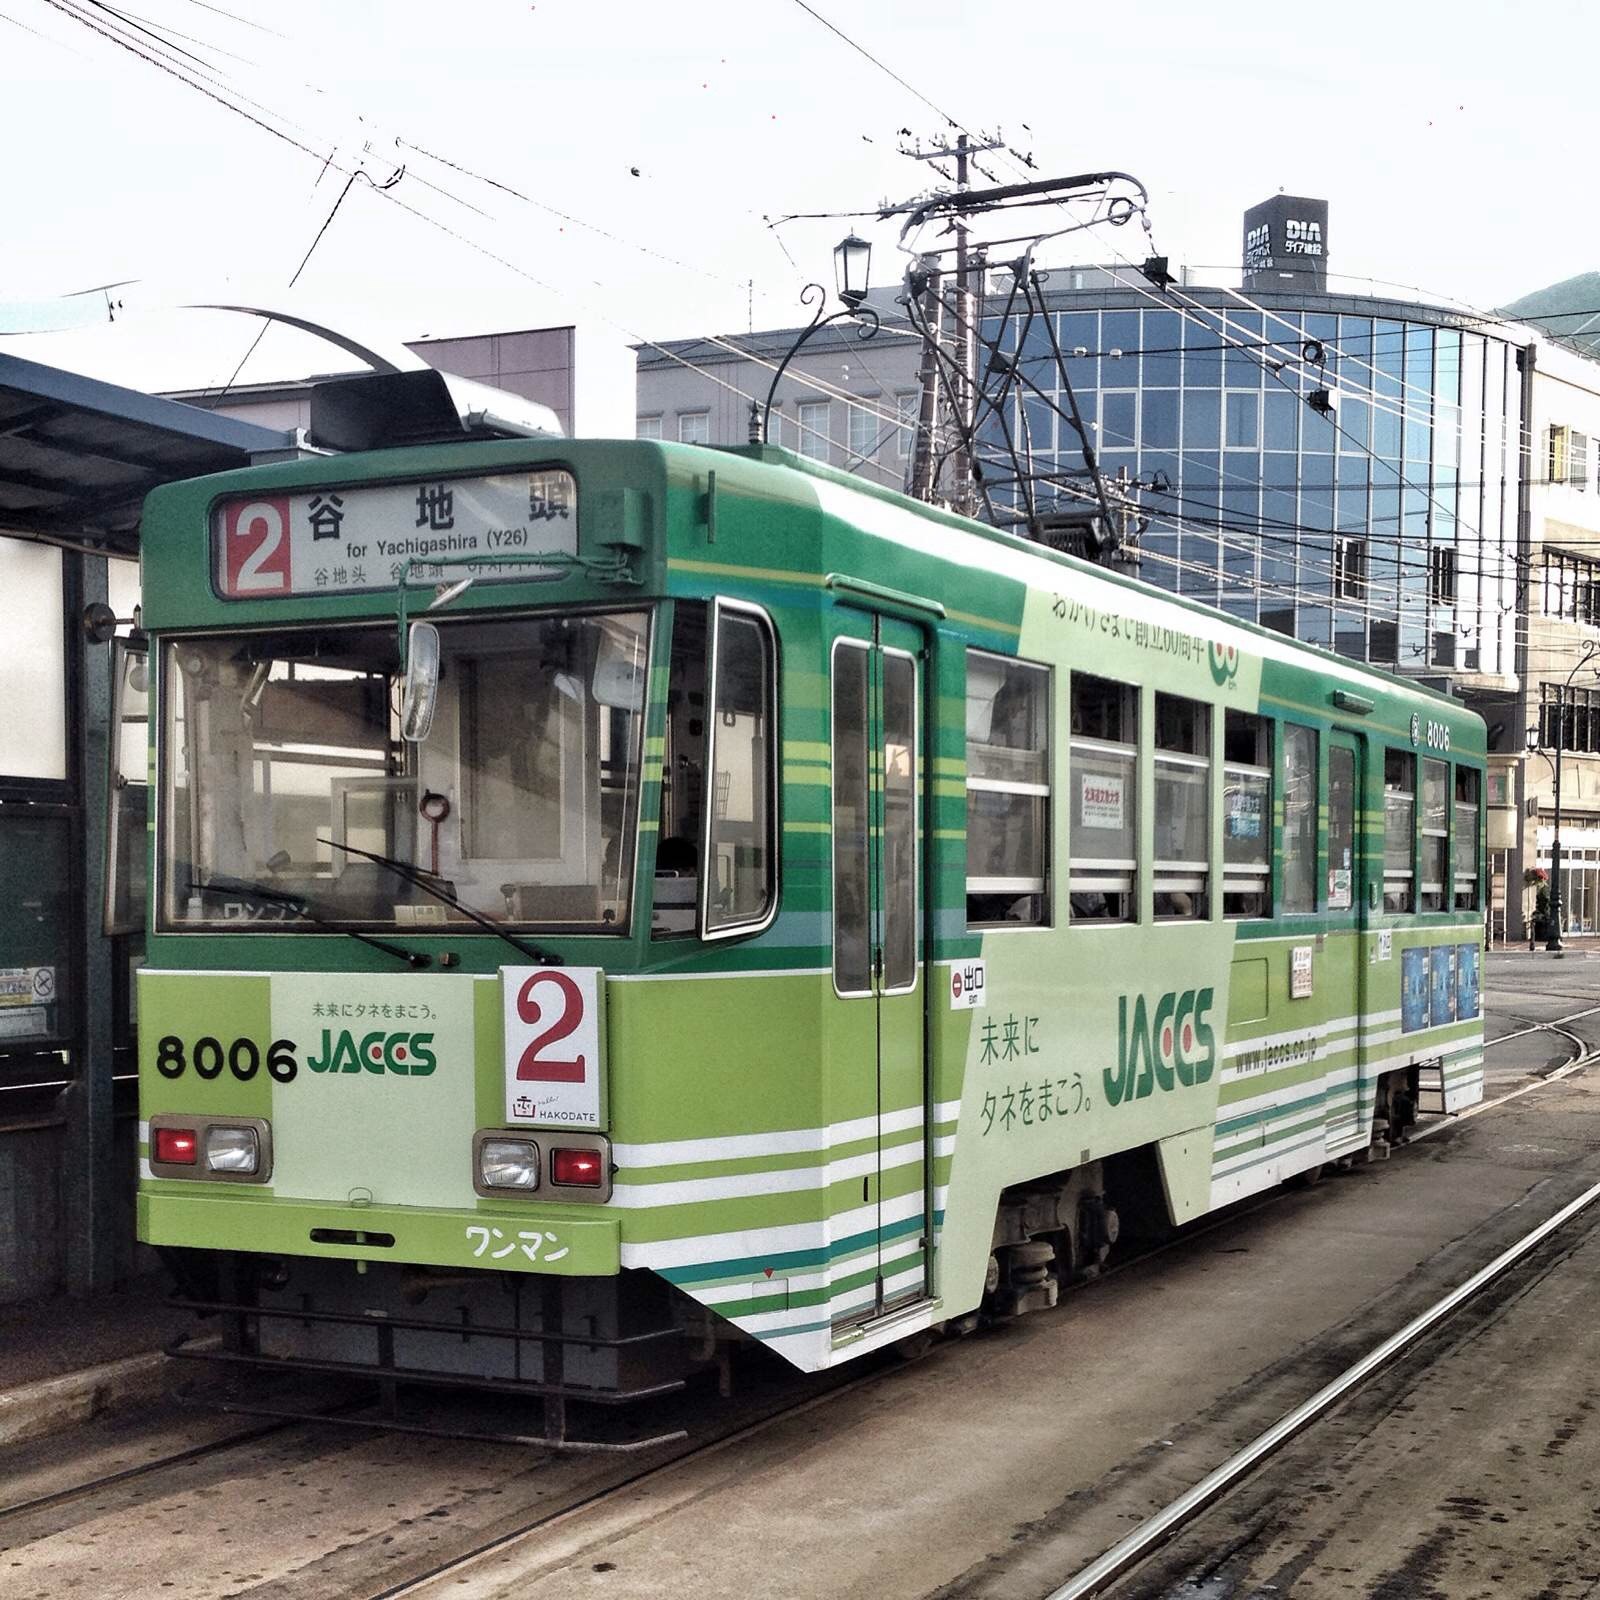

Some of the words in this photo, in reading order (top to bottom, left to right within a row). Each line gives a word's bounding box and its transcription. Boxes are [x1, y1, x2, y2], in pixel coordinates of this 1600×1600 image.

[1247, 223, 1270, 250] DIA
[1286, 219, 1321, 242] DIA
[235, 502, 285, 592] 2
[347, 543, 368, 559] for
[376, 534, 478, 557] Yachigashira
[486, 527, 529, 550] (Y26)
[314, 565, 367, 586] 谷地头
[1427, 719, 1450, 752] 8006
[964, 965, 984, 991] 出口
[312, 1001, 437, 1020] 未来にタネをまこう。
[516, 970, 586, 1084] 2
[307, 1029, 437, 1077] JACCS
[980, 1013, 1040, 1066] 未来に
[1103, 987, 1216, 1107] JACCS
[1235, 1031, 1318, 1074] www.jaccs.co.jp
[156, 1035, 298, 1084] 8006
[539, 1110, 596, 1122] HAKODATE
[980, 1072, 1091, 1137] タネをまこう。
[465, 1226, 570, 1262] ワンマン
